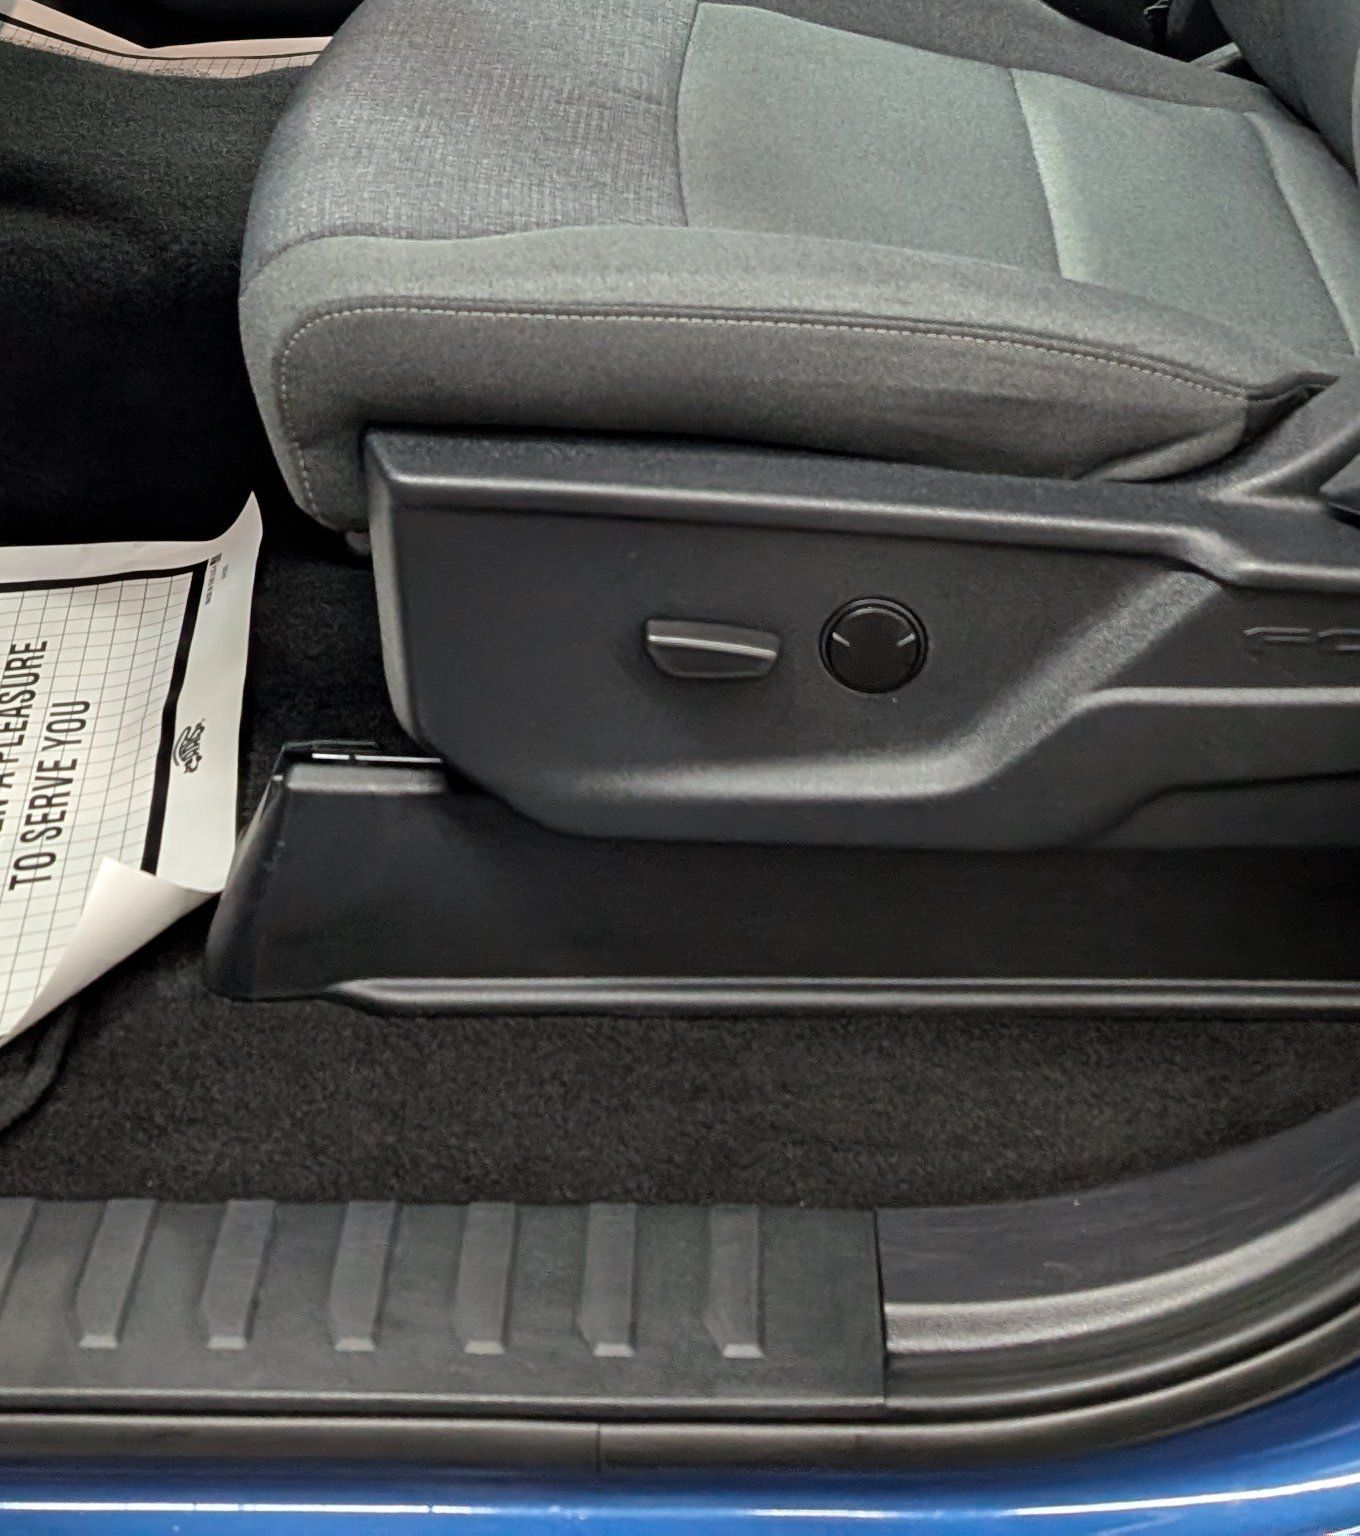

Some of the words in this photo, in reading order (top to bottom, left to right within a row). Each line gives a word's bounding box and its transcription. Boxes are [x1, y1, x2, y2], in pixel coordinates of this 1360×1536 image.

[42, 700, 90, 751] YOU
[20, 758, 78, 843] SERVE
[9, 852, 56, 891] TO
